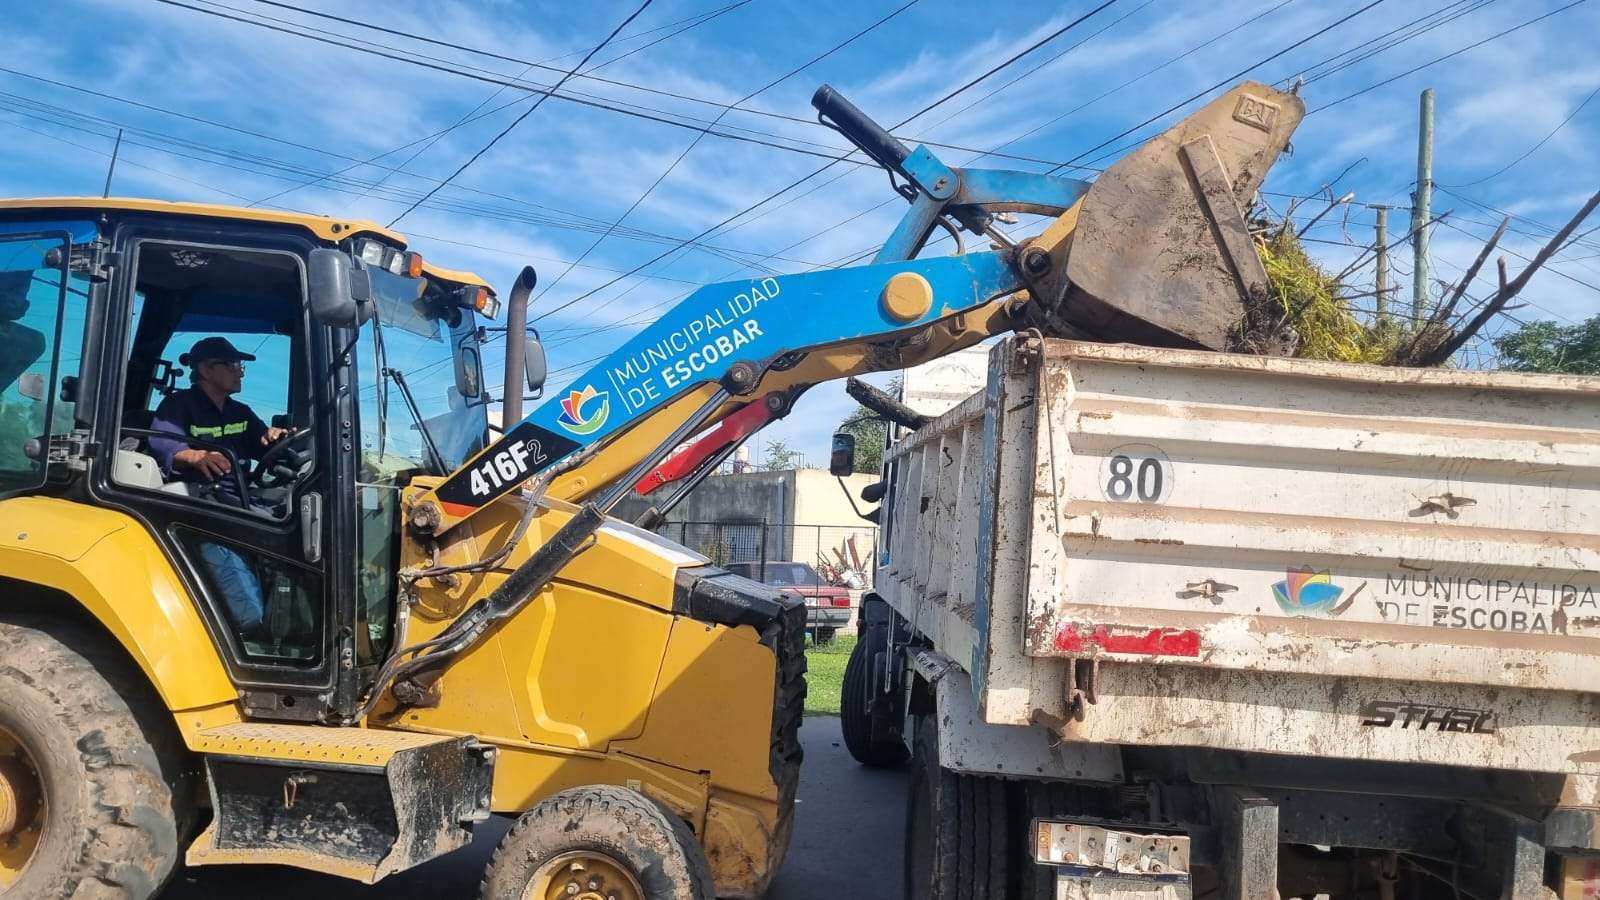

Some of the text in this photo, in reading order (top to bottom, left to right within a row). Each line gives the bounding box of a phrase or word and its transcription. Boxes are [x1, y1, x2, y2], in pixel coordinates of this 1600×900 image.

[614, 277, 780, 384] MUNICIPALIDAD
[627, 319, 764, 409] DE ESCOBAR
[470, 439, 548, 496] 416F2
[1107, 455, 1163, 502] 80
[1384, 602, 1420, 625] DE
